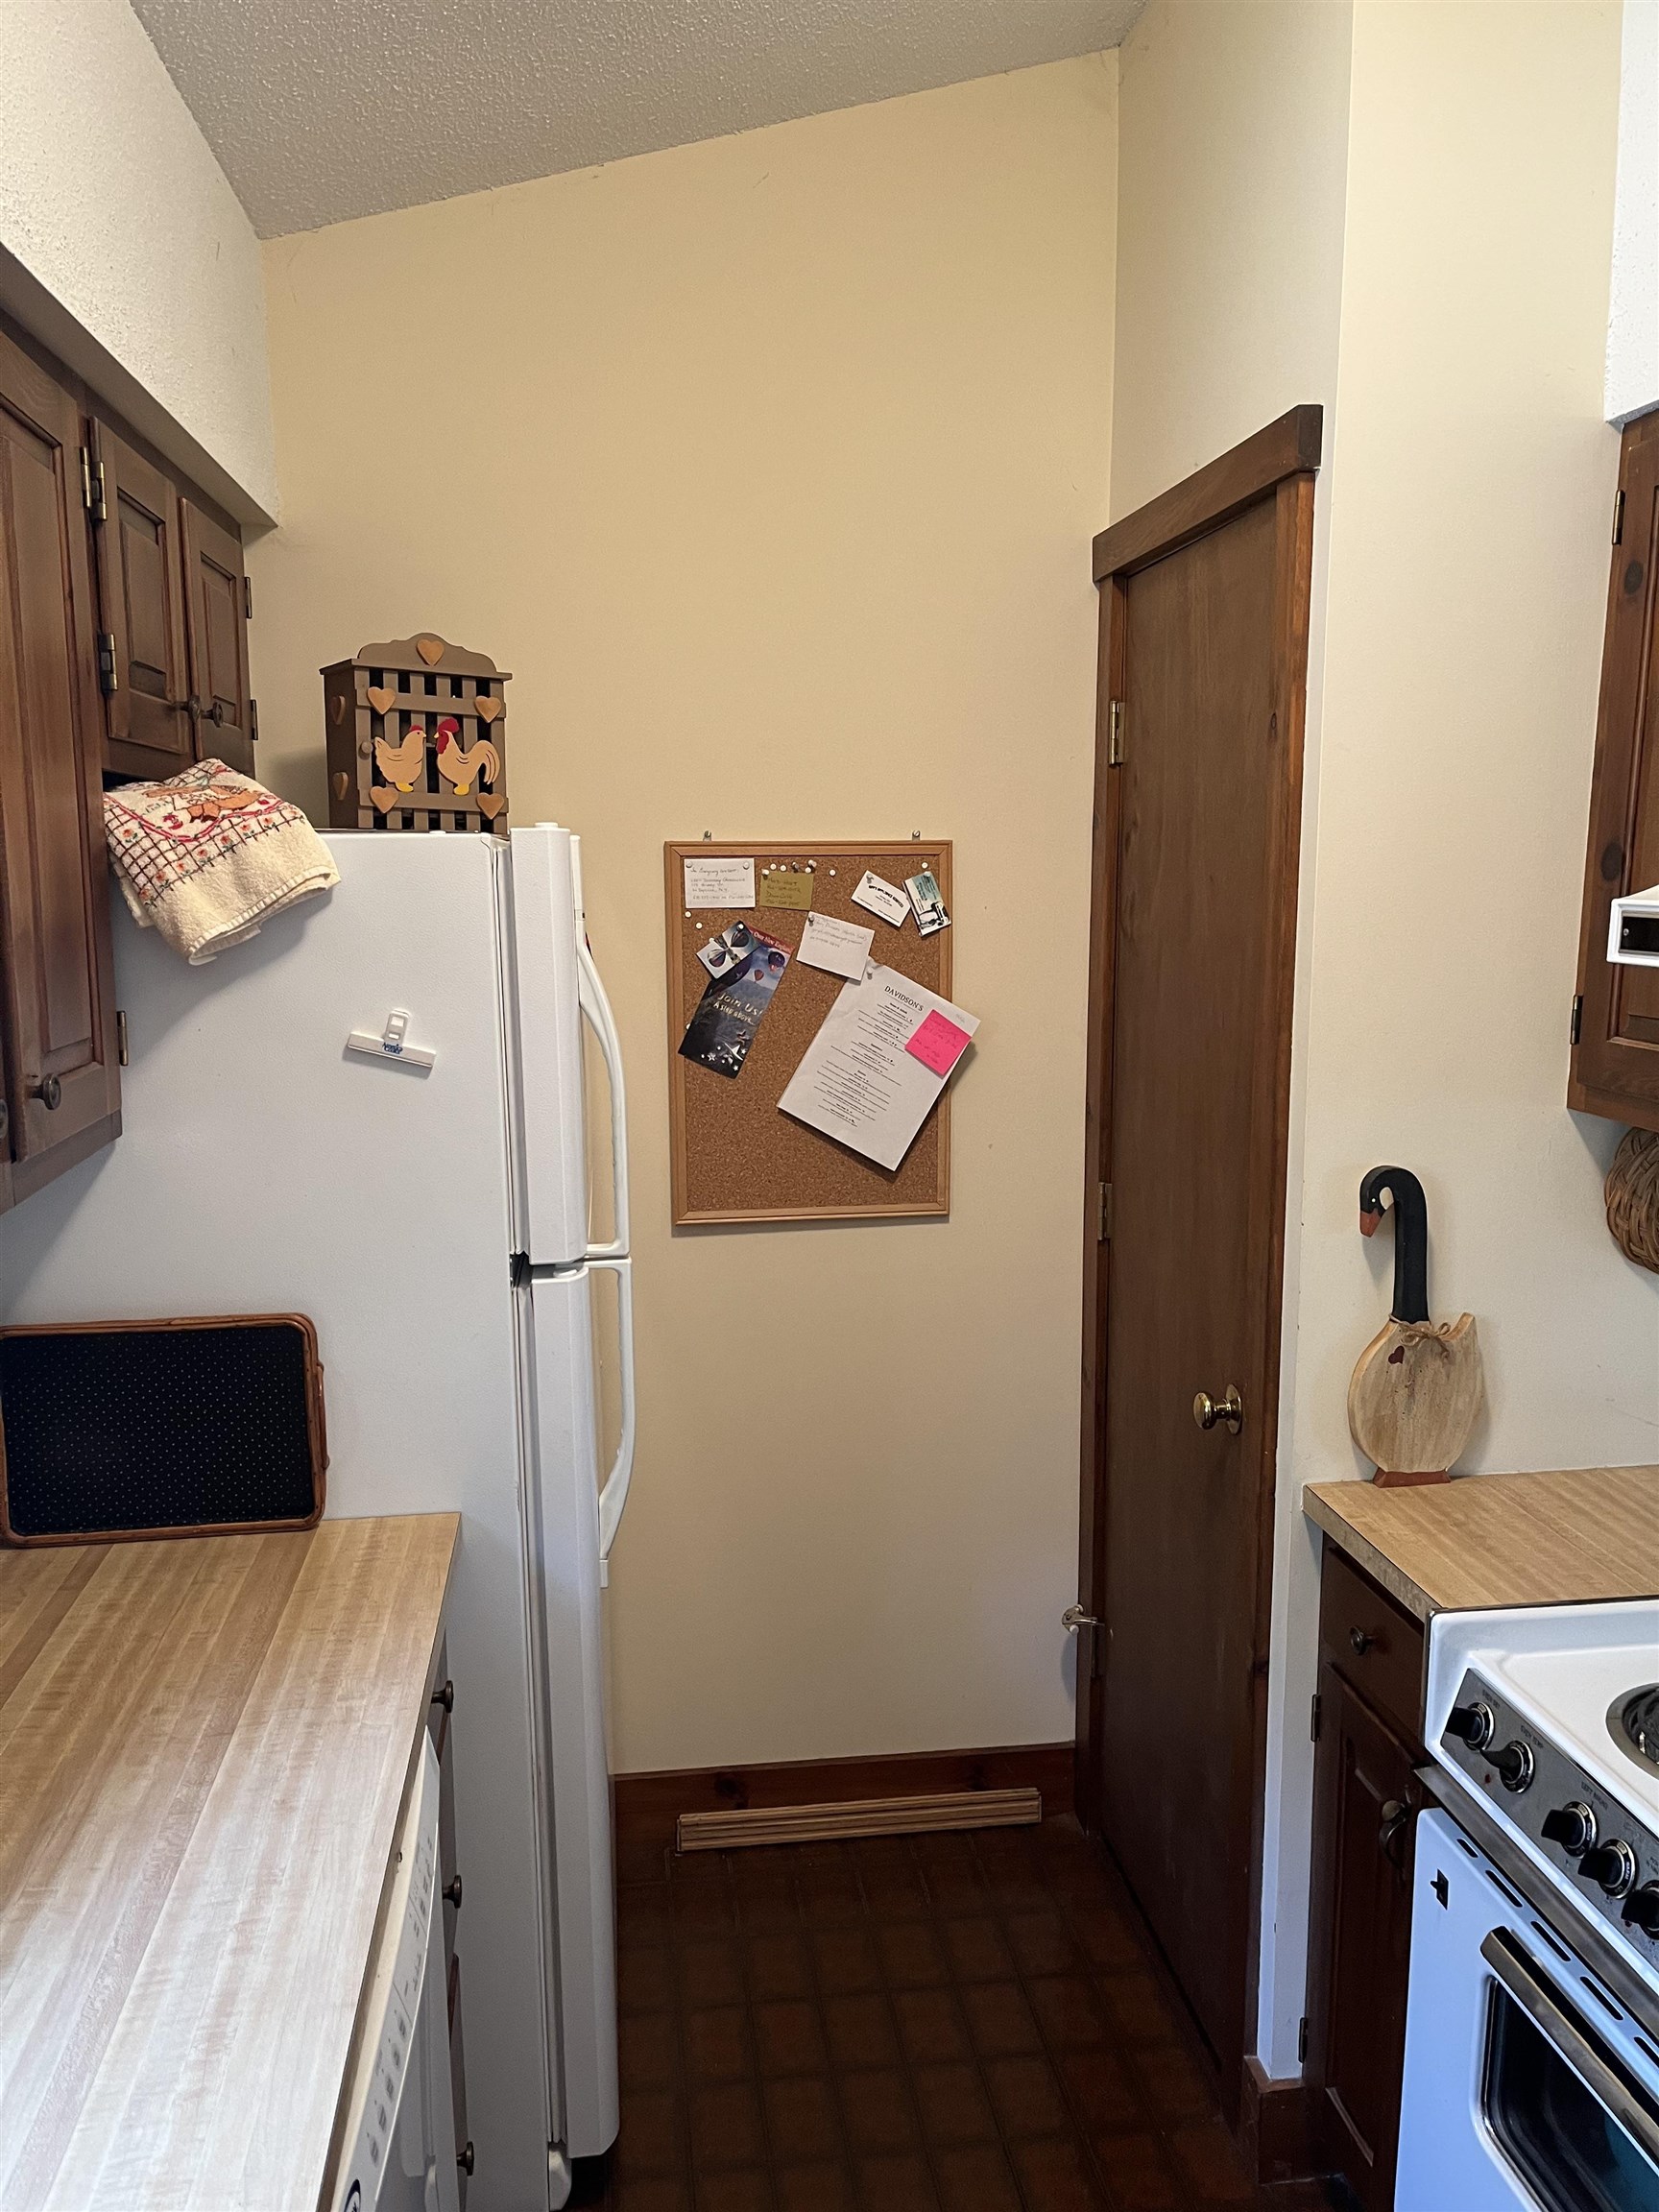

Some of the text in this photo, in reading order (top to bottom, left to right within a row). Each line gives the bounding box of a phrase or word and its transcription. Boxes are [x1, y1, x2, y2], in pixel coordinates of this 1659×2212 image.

[713, 1000, 720, 1009] A
[720, 1003, 733, 1015] step
[717, 992, 764, 1017] Join Us!
[884, 985, 924, 1011] DAVIDSON'S
